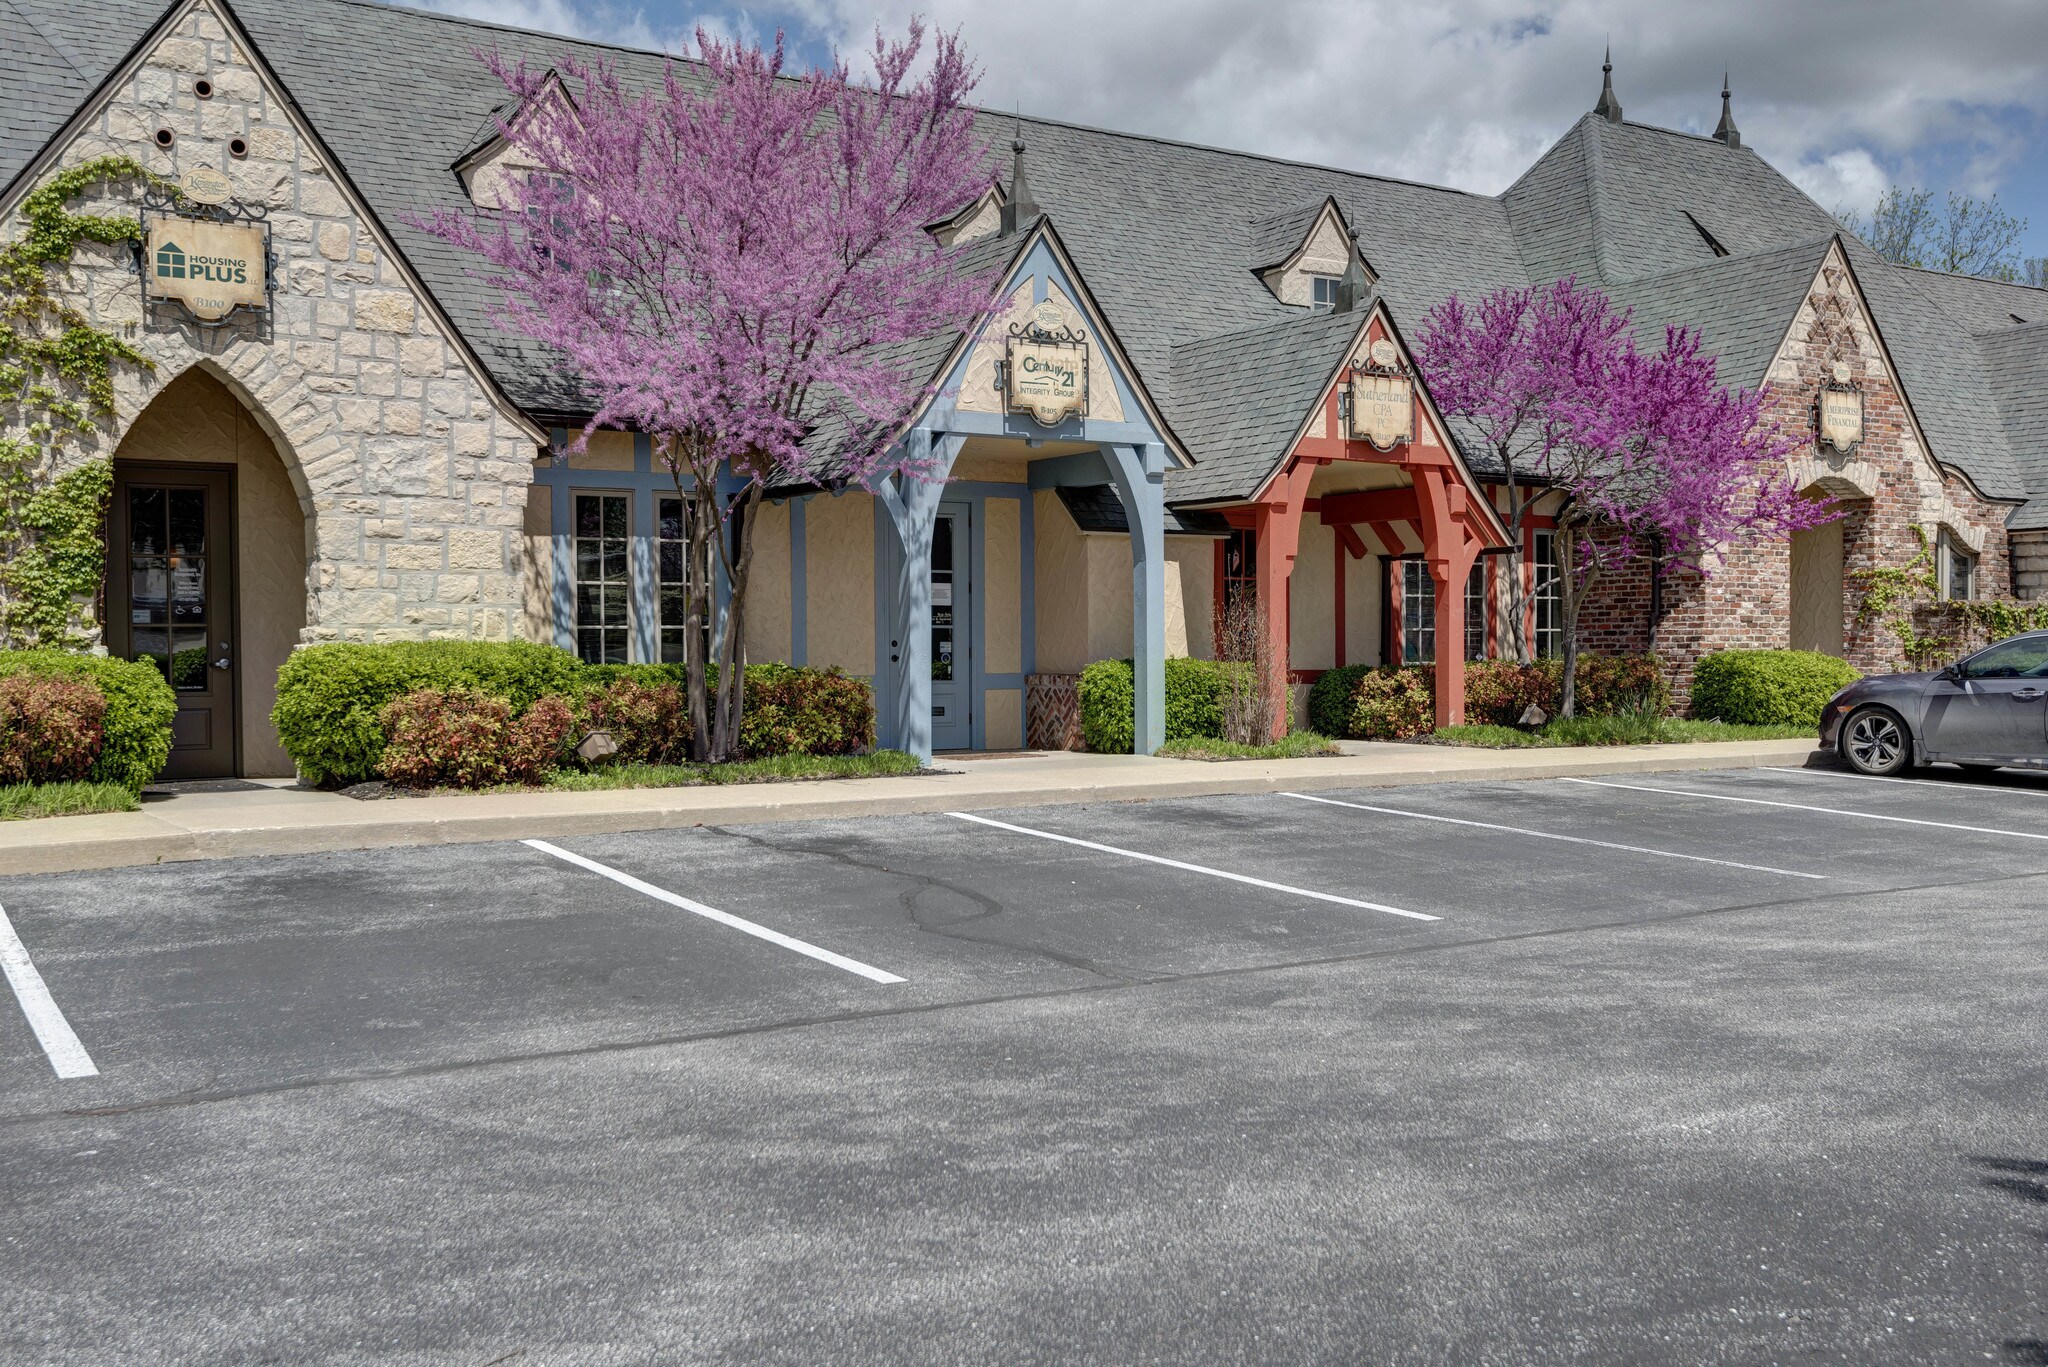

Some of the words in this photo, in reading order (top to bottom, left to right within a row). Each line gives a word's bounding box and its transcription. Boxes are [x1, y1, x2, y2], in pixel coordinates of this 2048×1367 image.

[190, 255, 246, 267] HOUSING
[190, 264, 246, 284] PLUS
[194, 297, 224, 308] B100
[1023, 356, 1064, 377] Century
[1061, 371, 1075, 388] 21
[1020, 387, 1051, 396] INTEGRITY
[1053, 388, 1075, 398] GROUP
[1356, 384, 1409, 404] Sutherland
[1373, 403, 1393, 416] CPA
[1825, 405, 1859, 416] AMERIPRISE
[1376, 417, 1389, 429] PC
[1827, 415, 1858, 427] FINANCIAL
